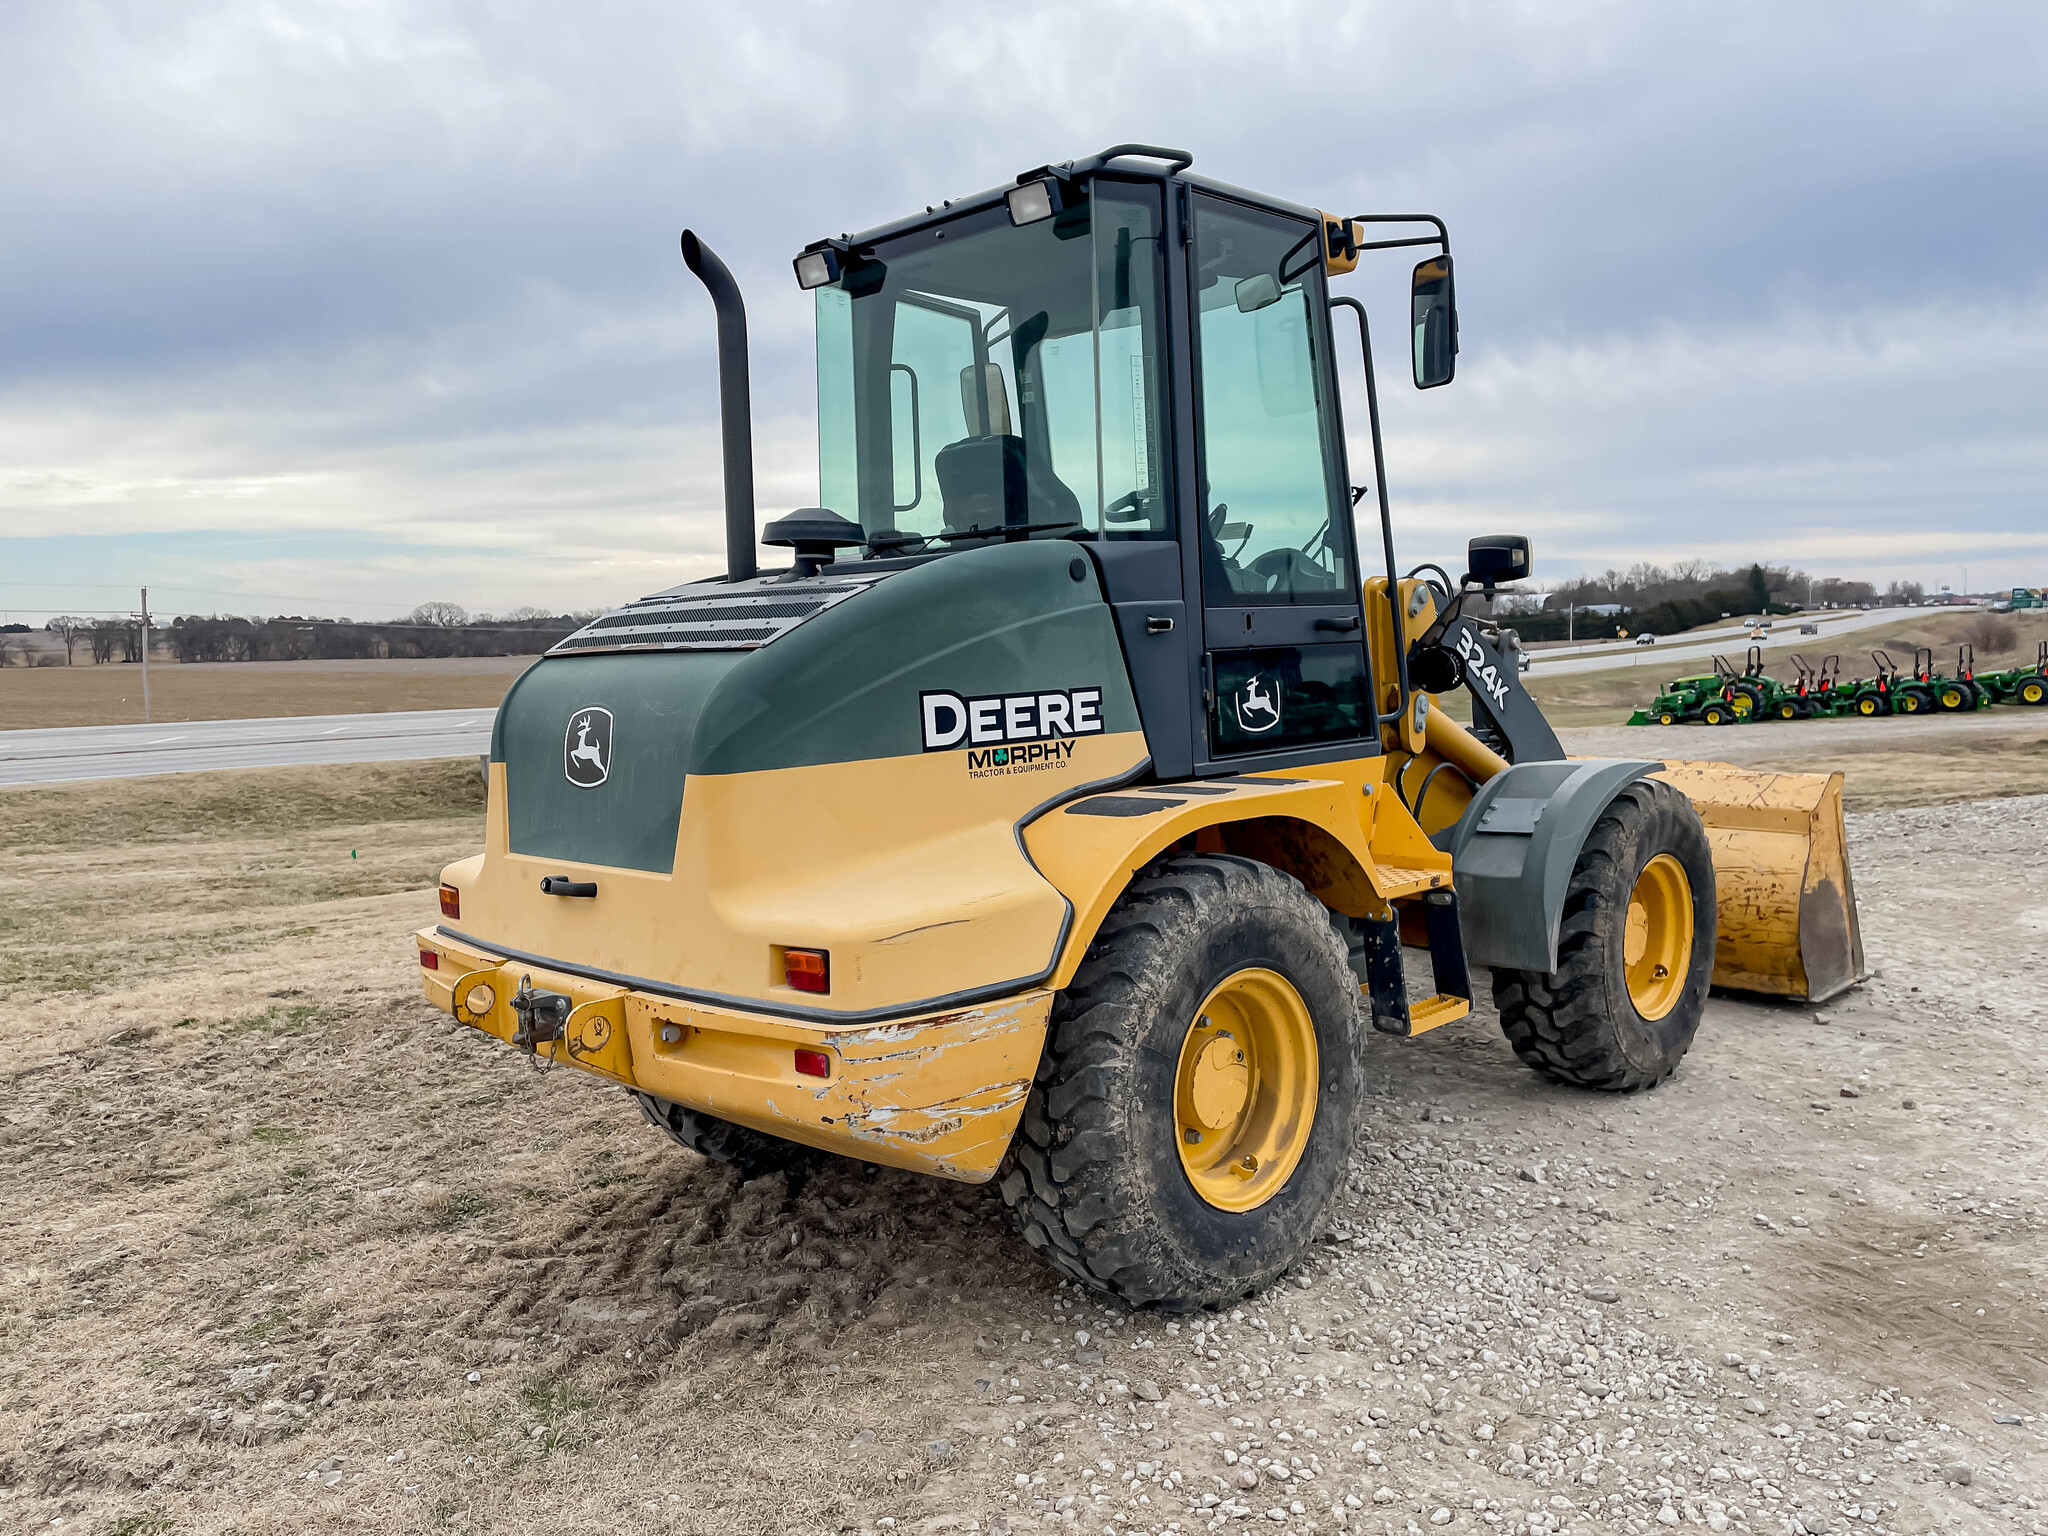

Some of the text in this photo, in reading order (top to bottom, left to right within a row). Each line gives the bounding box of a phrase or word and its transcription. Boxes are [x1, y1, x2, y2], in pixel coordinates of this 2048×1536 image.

[1456, 626, 1510, 711] 324K
[922, 690, 1102, 748] DEERE
[967, 739, 1077, 770] MURPHY
[968, 760, 1068, 780] TRACTOR & EQUIPMENT CO.
